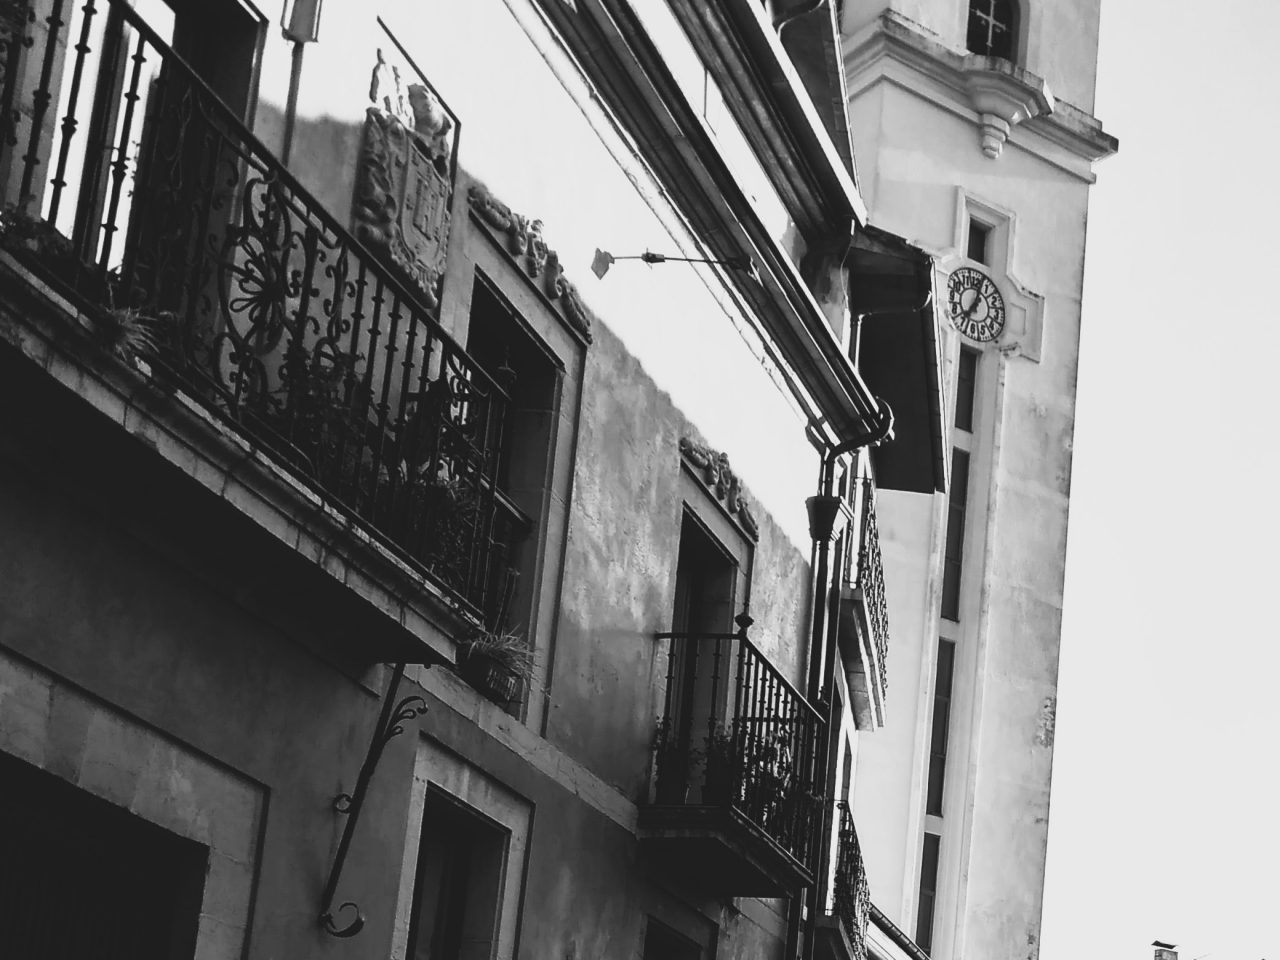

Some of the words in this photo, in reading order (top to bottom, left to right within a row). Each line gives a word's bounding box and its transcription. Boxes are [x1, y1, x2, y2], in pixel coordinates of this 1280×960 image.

[953, 278, 961, 291] 10
[962, 274, 969, 286] 11
[984, 284, 989, 294] 1
[949, 290, 955, 301] 9
[991, 295, 997, 307] 2
[952, 303, 957, 314] 8
[993, 309, 999, 320] 3
[960, 316, 966, 327] 7
[989, 319, 995, 331] 4
[970, 323, 975, 334] 6
[980, 324, 985, 335] 5
